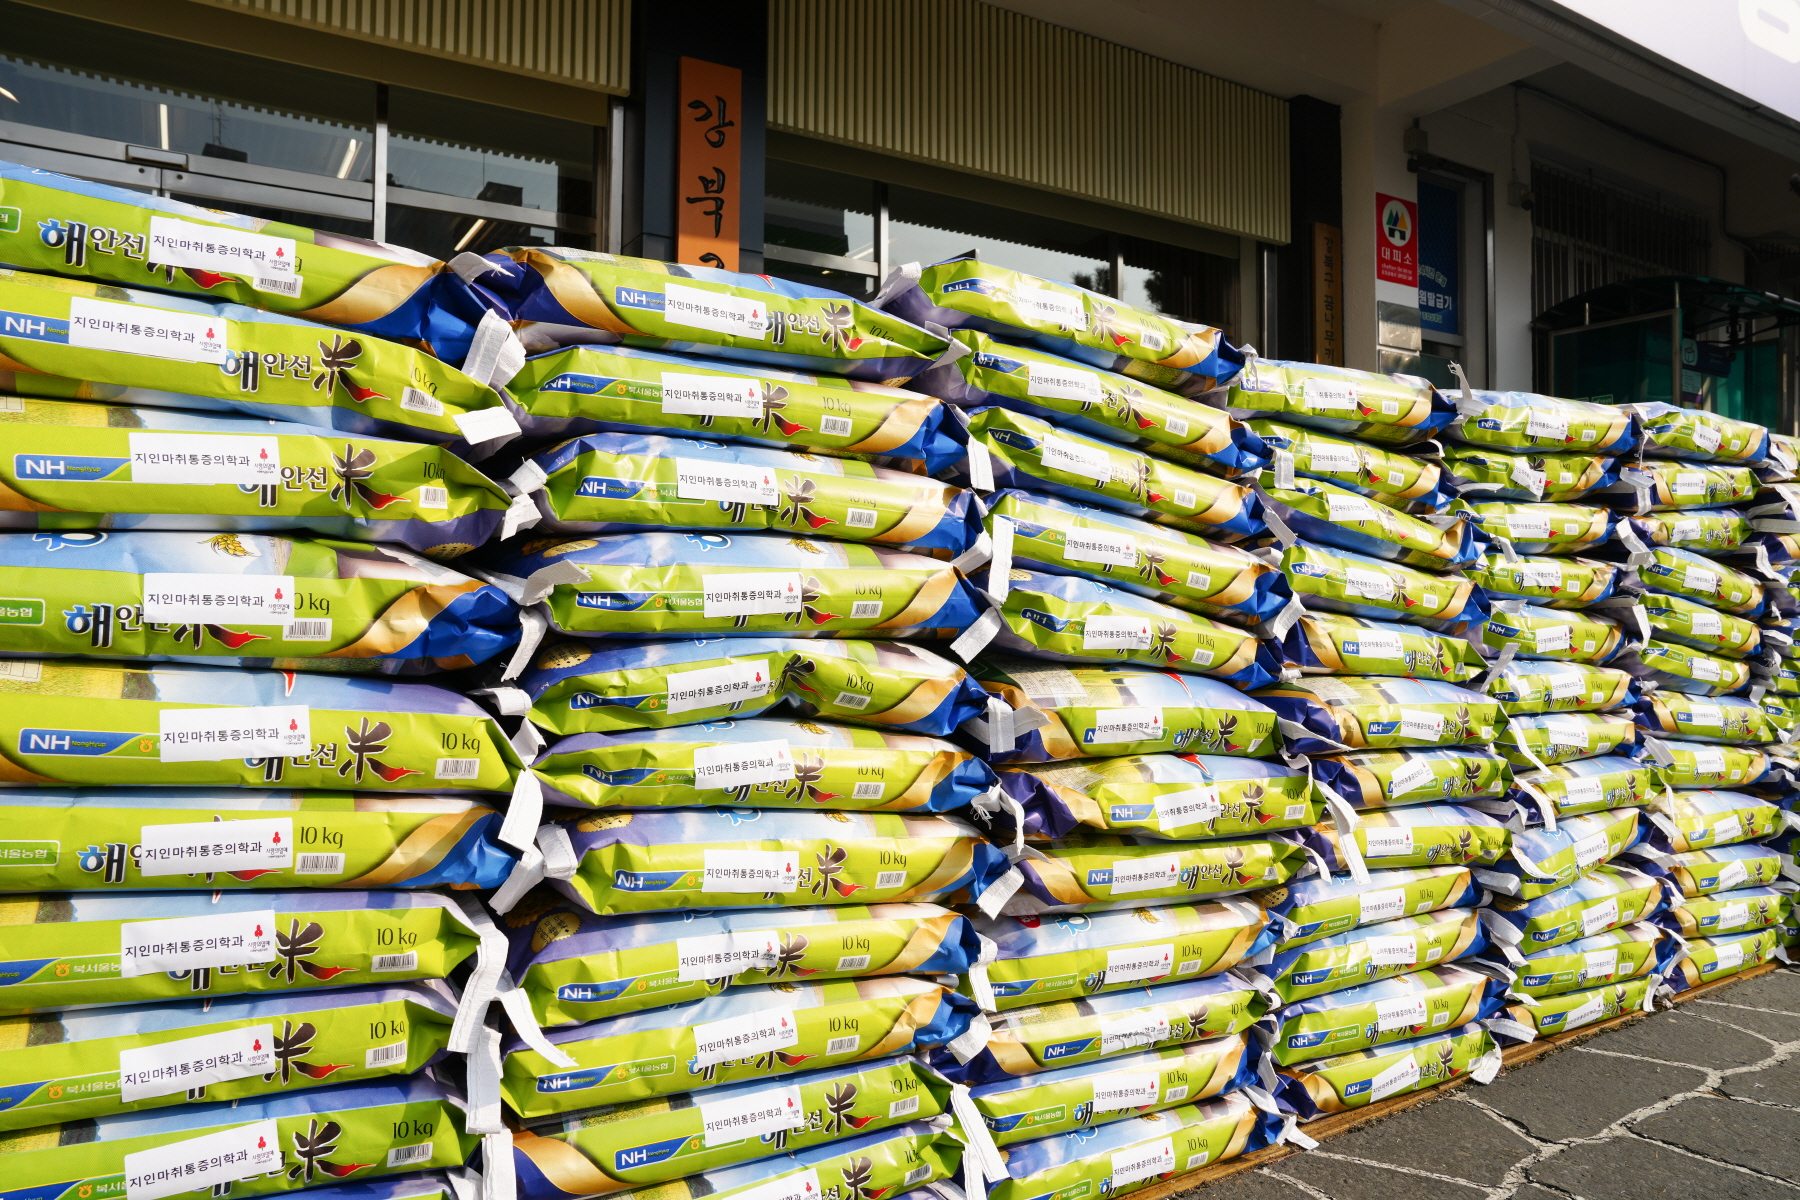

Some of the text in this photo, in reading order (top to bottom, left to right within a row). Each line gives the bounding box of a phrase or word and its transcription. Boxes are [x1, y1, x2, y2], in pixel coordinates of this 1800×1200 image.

[686, 95, 734, 268] 강북
[37, 218, 147, 267] 해안선
[153, 234, 266, 261] 지인마취통증의학과
[1381, 246, 1413, 265] 대피소
[621, 289, 647, 305] NH
[667, 298, 745, 324] 지인마취통증의학과
[4, 317, 46, 336] NH
[74, 315, 195, 344] 지인마취통증의학과
[312, 334, 384, 401] 米
[665, 387, 741, 404] 지인마취통증의학과
[25, 459, 66, 475] NH
[135, 452, 250, 467] 지인마취통증의학과
[580, 481, 607, 495] NH
[679, 473, 757, 491] 지인마취통증의학과
[1066, 539, 1121, 555] 지인마취통증의학과
[148, 592, 264, 608] 지인마취통증의학과
[308, 592, 330, 615] kg
[582, 594, 611, 607] NH
[706, 588, 781, 604] 지인마취통증의학과
[1085, 629, 1138, 640] 지인마취통증의학과
[1345, 643, 1357, 652] NH
[670, 680, 749, 702] 지인마취통증의학과
[1097, 720, 1150, 733] 지인마취통증의학과
[1370, 724, 1383, 733] NH
[29, 735, 70, 751] NH
[163, 727, 279, 744] 지인마취통증의학과
[696, 758, 774, 777] 지인마취통증의학과
[1115, 808, 1133, 818] NH
[1158, 802, 1208, 818] 지인마취통증의학과
[145, 841, 262, 860] 지인마취통증의학과
[616, 871, 644, 888] NH
[706, 867, 779, 881] 지인마취통증의학과
[1090, 873, 1109, 883] NH
[1114, 872, 1166, 884] 지인마취통증의학과
[1180, 865, 1223, 891] 해안선
[125, 934, 243, 958] 지인마취통증의학과
[681, 949, 760, 967] 지인마취통증의학과
[1108, 959, 1160, 973] 지인마취통증의학과
[1295, 973, 1312, 984] NH
[564, 986, 592, 1000] NH
[698, 1027, 776, 1053] 지인마취통증의학과
[1291, 1036, 1308, 1047] NH
[1048, 1045, 1066, 1057] NH
[124, 1052, 243, 1087] 지인마취통증의학과
[543, 1075, 571, 1090] NH
[1347, 1083, 1360, 1094] NH
[1095, 1087, 1147, 1099] 지인마취통증의학과
[705, 1107, 782, 1132] 지인마취통증의학과
[620, 1147, 648, 1165] NH
[129, 1149, 248, 1188] 지인마취통증의학과
[1113, 1156, 1163, 1176] 지인마취통증의학과
